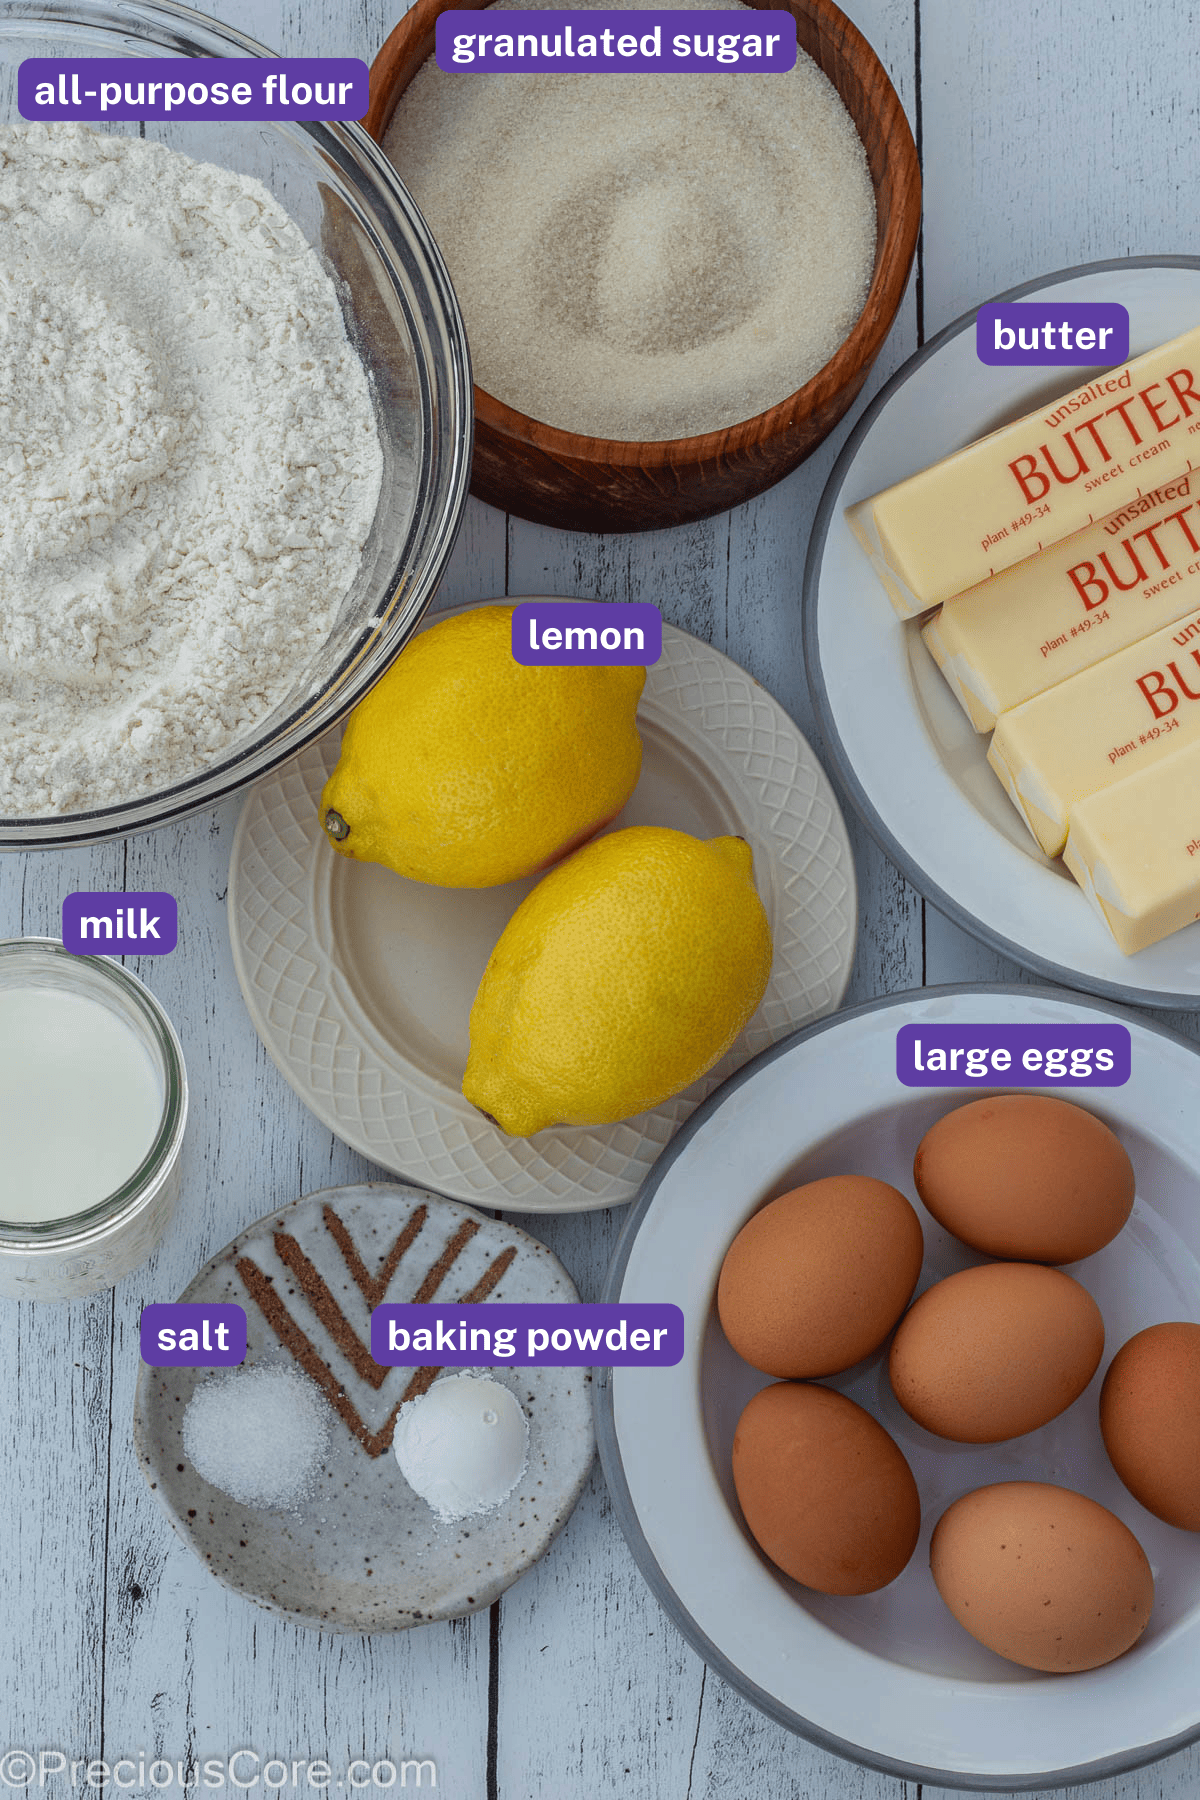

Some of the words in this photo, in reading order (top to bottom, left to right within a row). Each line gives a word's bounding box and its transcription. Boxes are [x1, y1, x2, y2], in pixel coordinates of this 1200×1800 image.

[1044, 369, 1132, 429] unsalted
[1007, 367, 1200, 505] BUTTER
[1084, 464, 1125, 493] sweet
[1129, 439, 1171, 467] cream
[981, 528, 1009, 552] plant
[1010, 503, 1051, 532] #49-34
[1103, 477, 1191, 535] unsalted
[1066, 499, 1200, 611] BUTT
[1143, 571, 1183, 599] sweet
[1040, 633, 1068, 659] plant
[1069, 609, 1110, 638] #49-34
[1108, 740, 1137, 765] plant
[1139, 717, 1180, 745] #49-34
